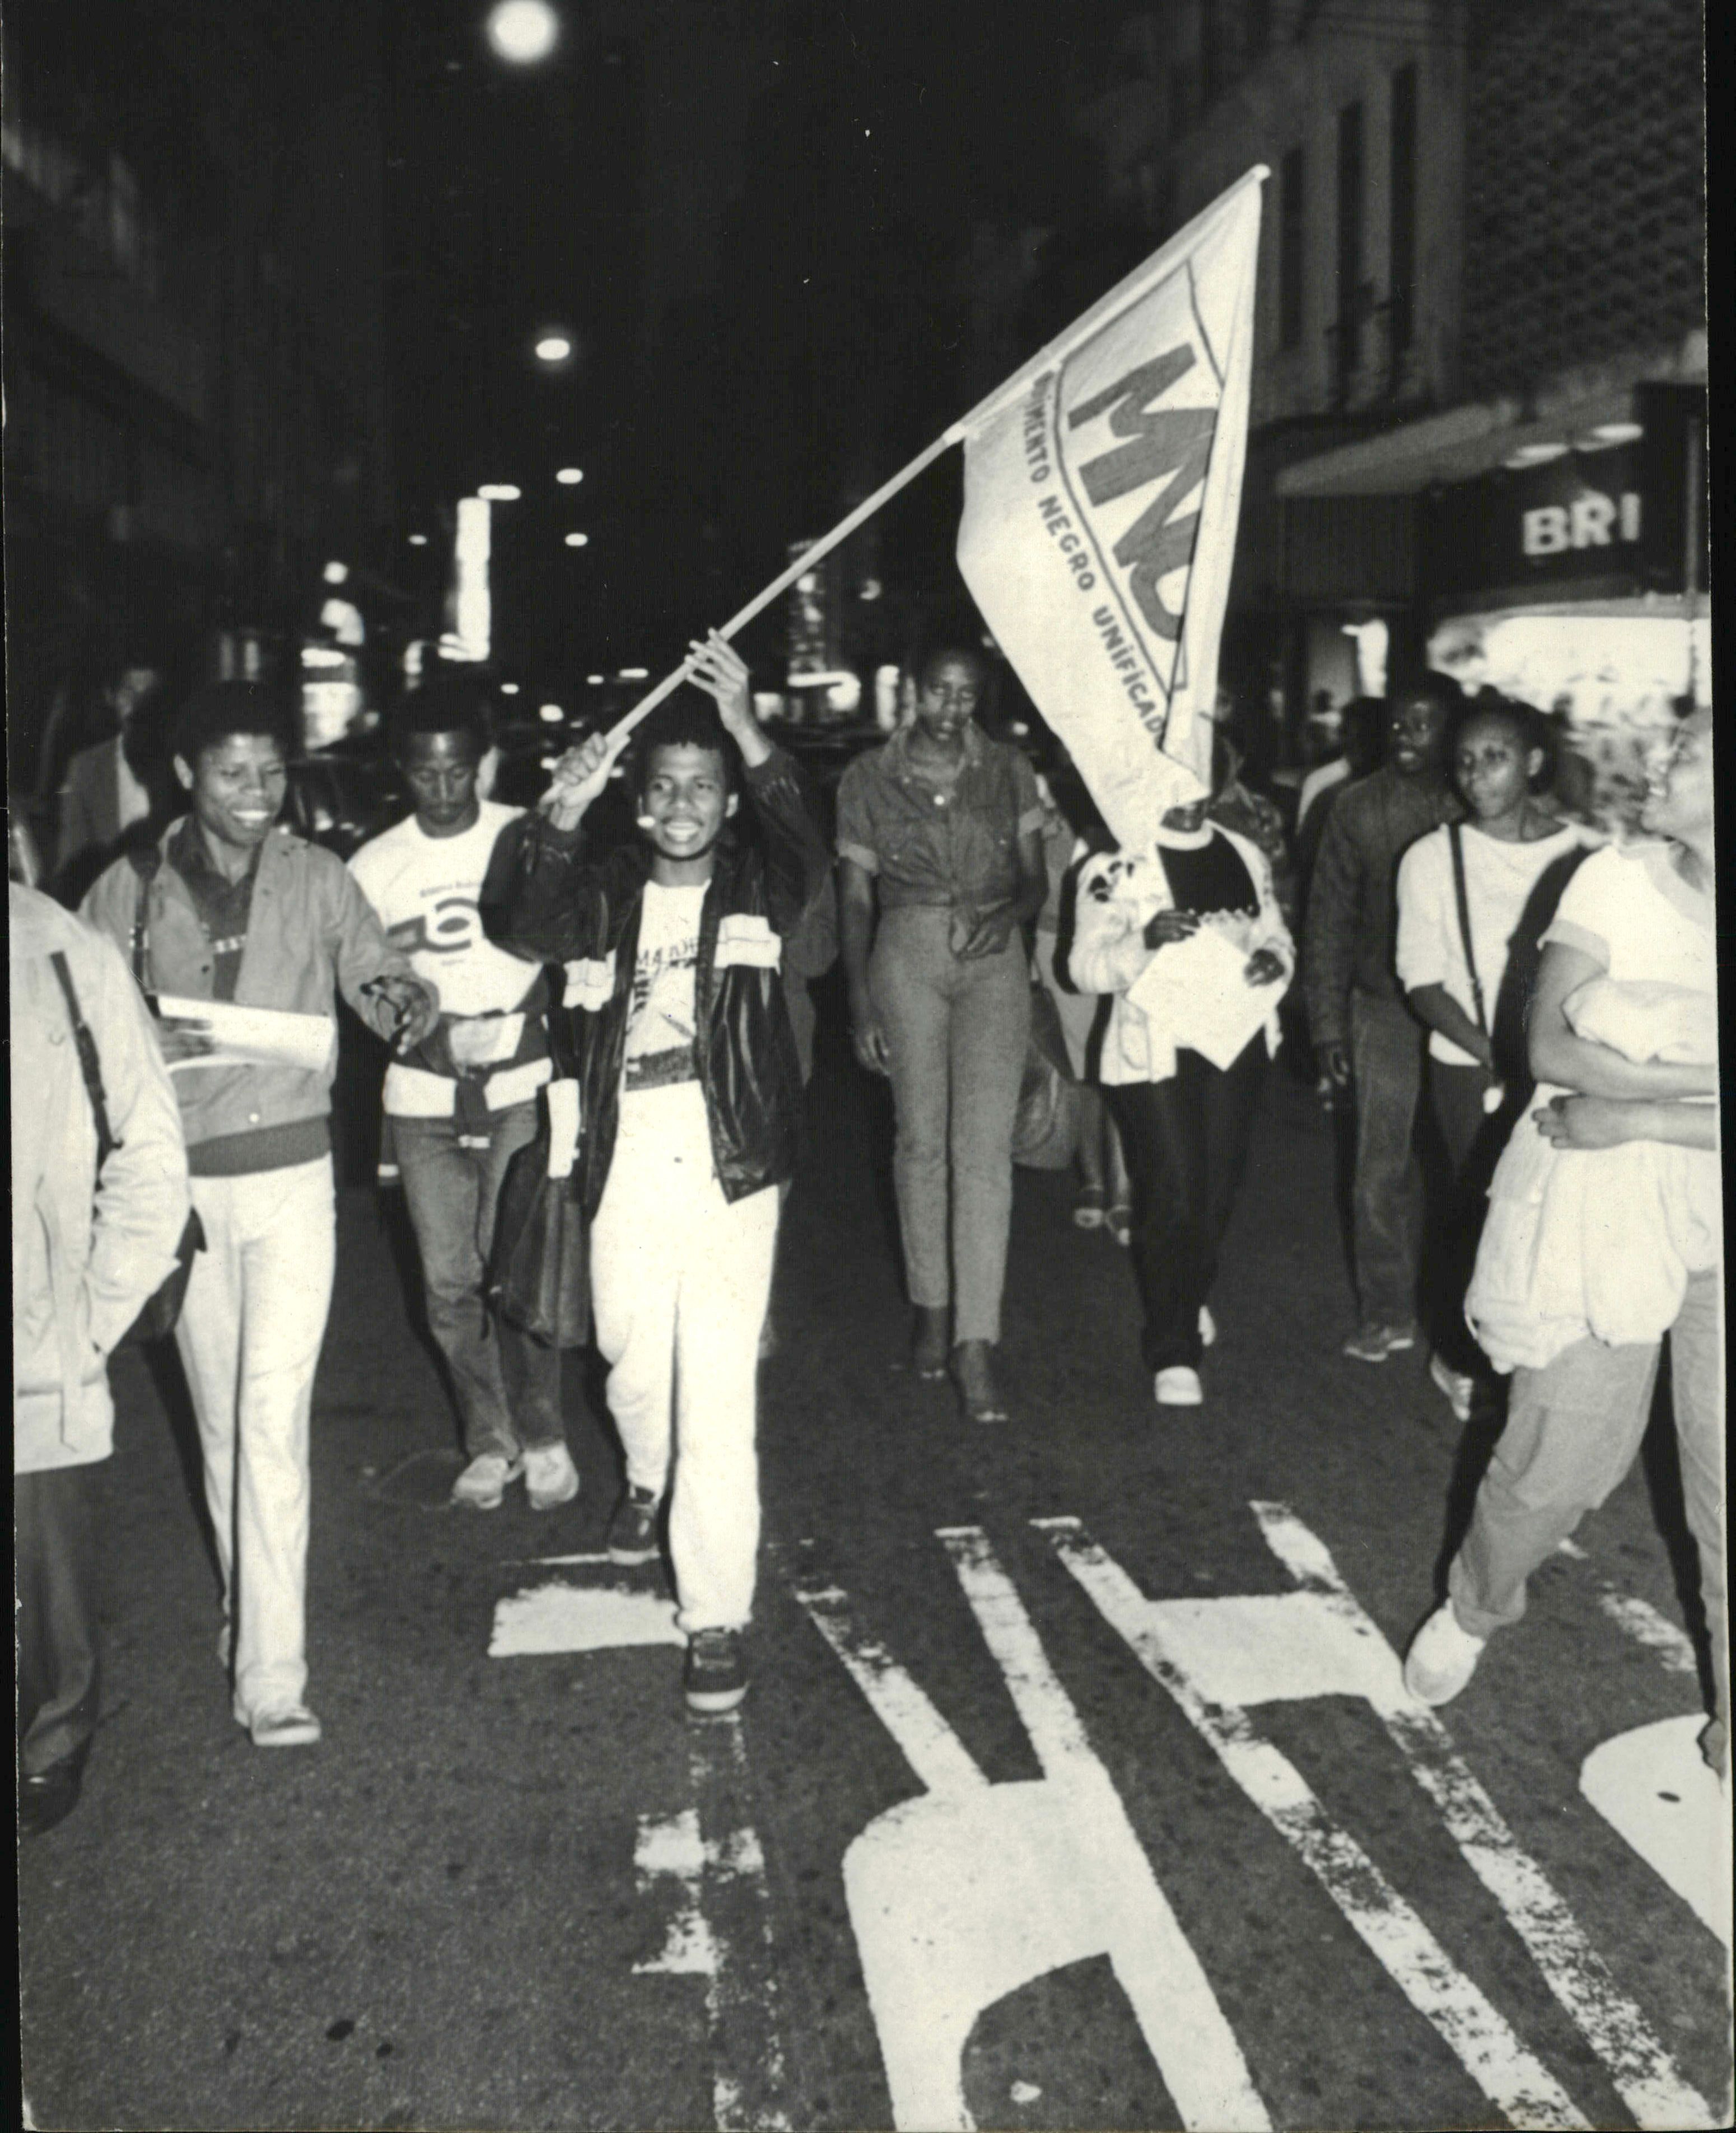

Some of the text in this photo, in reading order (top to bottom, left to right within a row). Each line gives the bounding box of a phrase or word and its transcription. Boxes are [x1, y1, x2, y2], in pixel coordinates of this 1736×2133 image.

[1067, 339, 1220, 643] MNU
[1522, 487, 1641, 556] BRI
[1037, 494, 1095, 592] NEGRO
[1093, 605, 1168, 752] UNIFICAD
